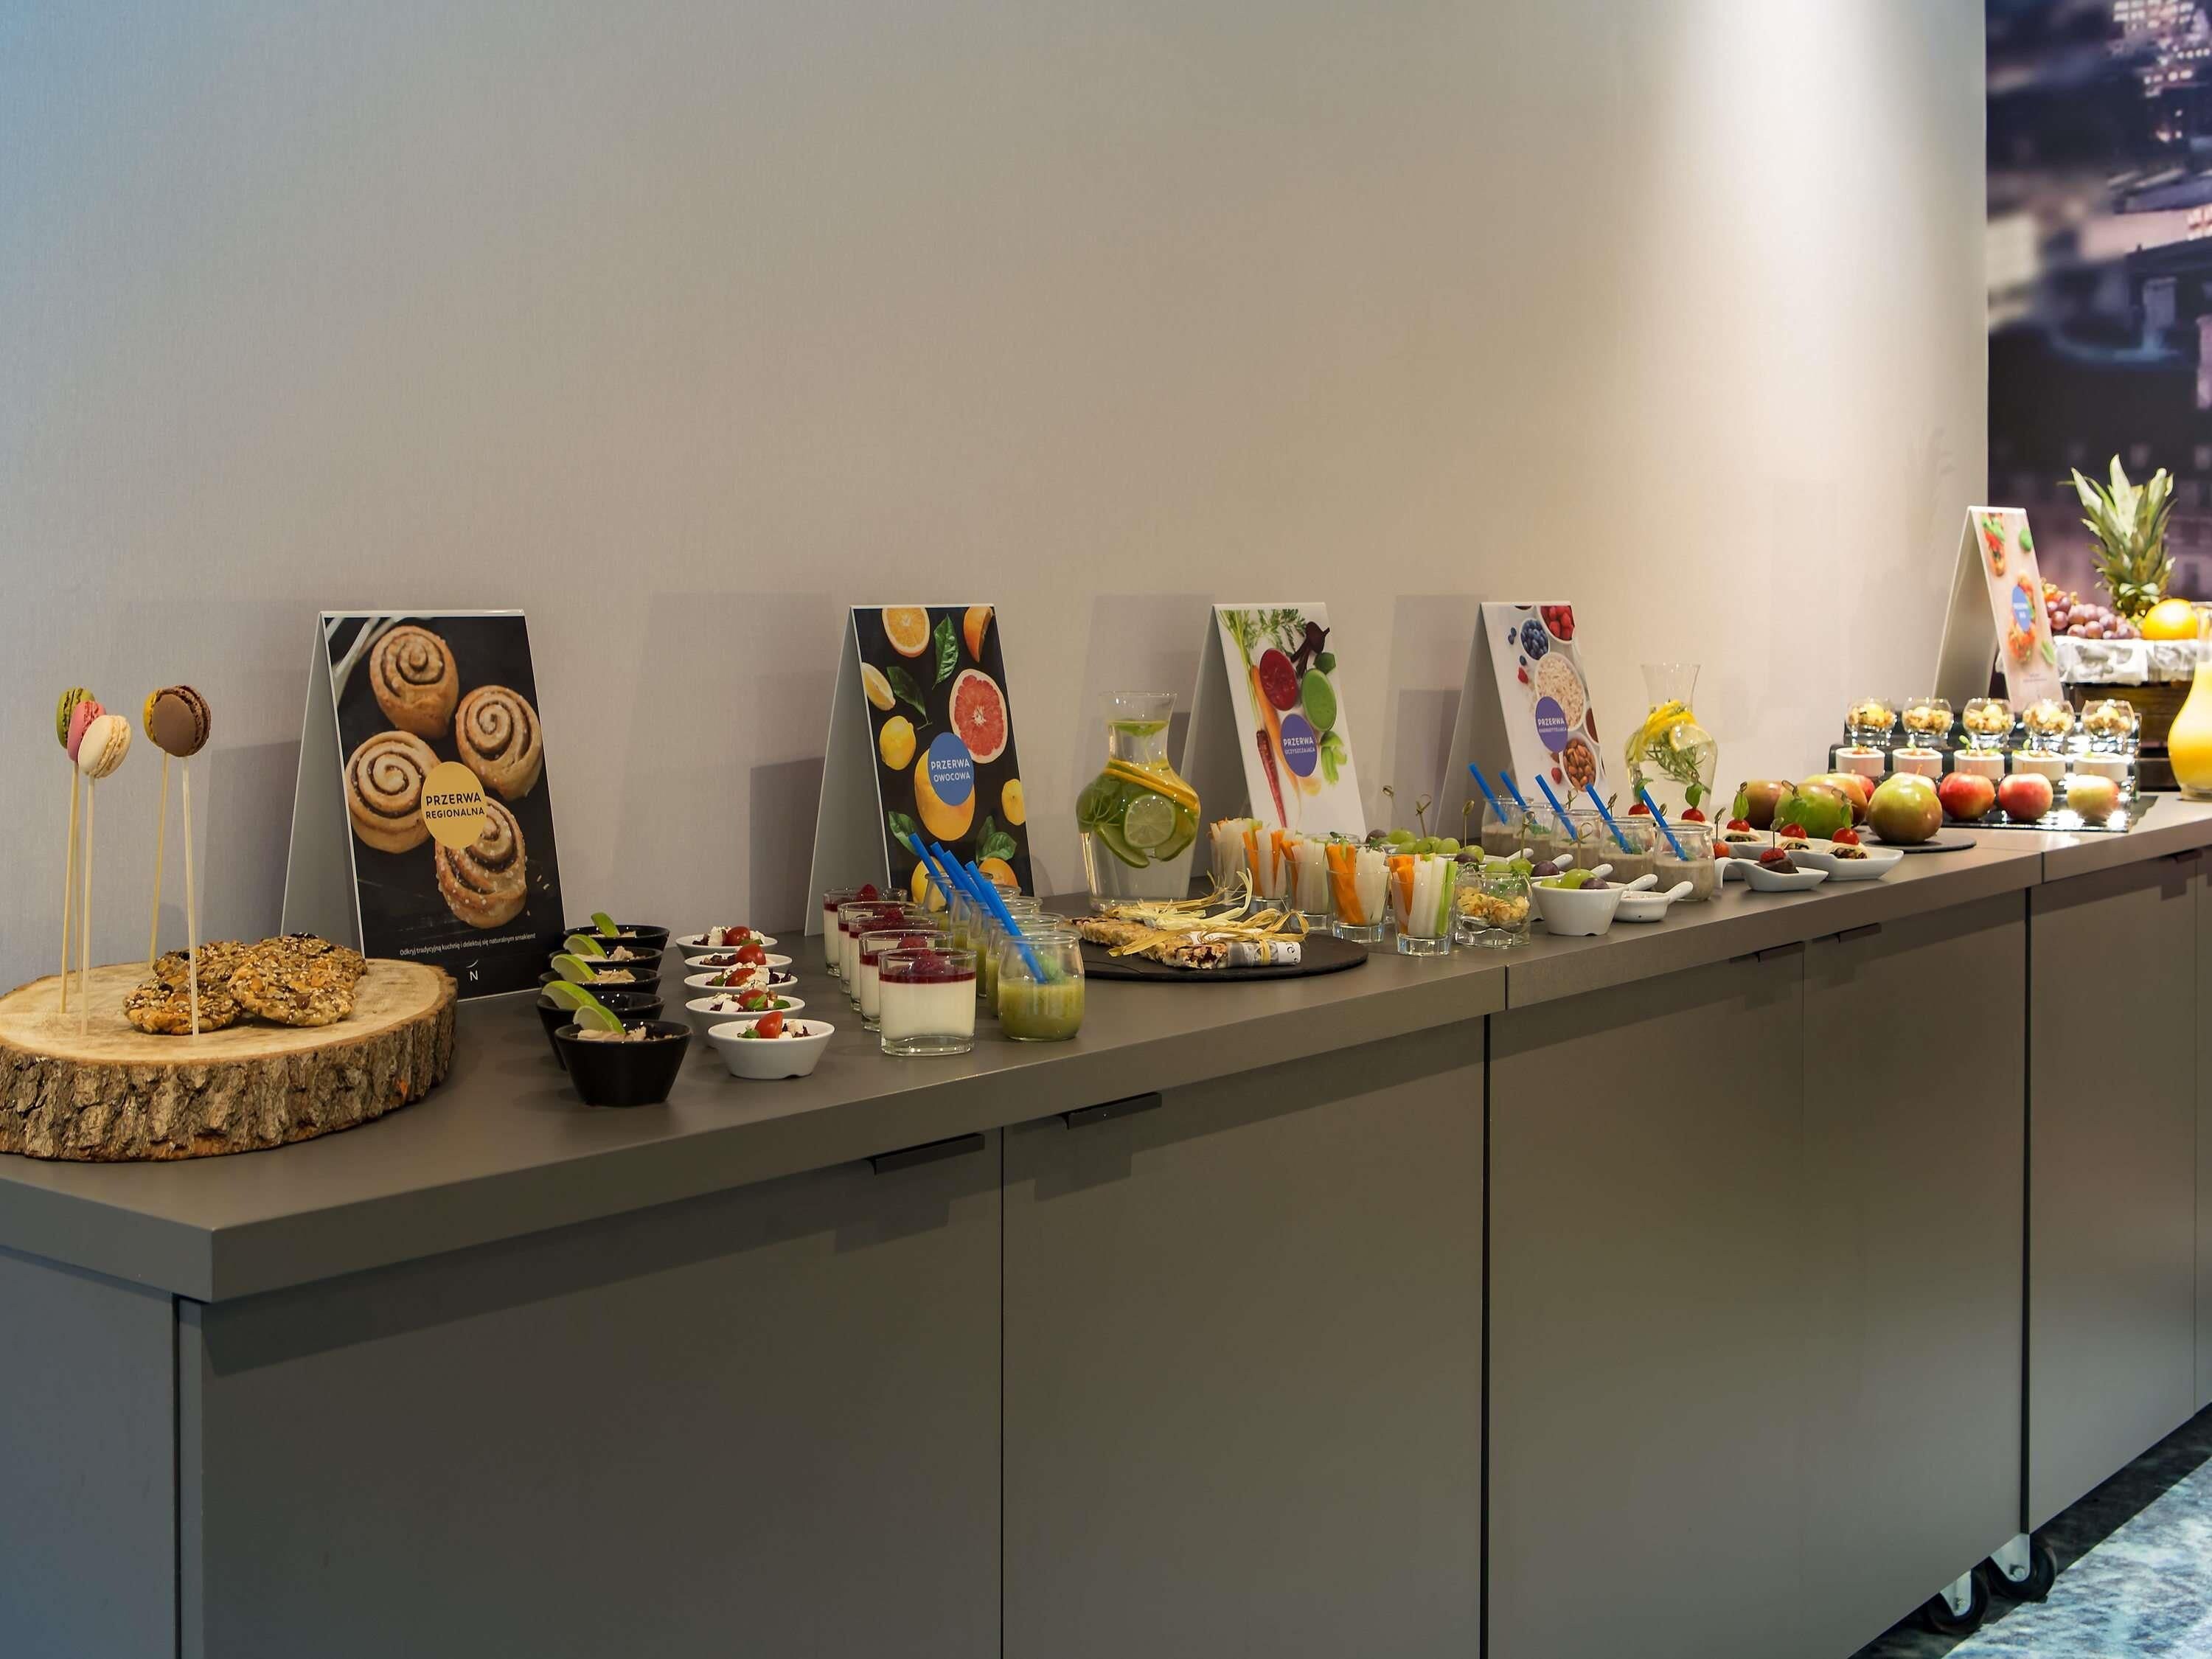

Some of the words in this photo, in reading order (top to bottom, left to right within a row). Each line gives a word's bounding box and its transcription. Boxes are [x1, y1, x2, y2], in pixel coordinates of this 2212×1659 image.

[1538, 717, 1565, 726] PRZERWA
[1283, 737, 1314, 747] PRZERWA
[931, 758, 970, 771] PRZERWA
[933, 771, 970, 782] OWOCOWA
[425, 792, 481, 806] PRZERWA
[425, 807, 484, 819] REGIONALNA
[400, 947, 417, 956] Odkryj
[417, 945, 442, 954] tradycyjną
[463, 939, 481, 947] delektuj
[489, 935, 515, 944] naturalnym
[470, 970, 479, 981] N
